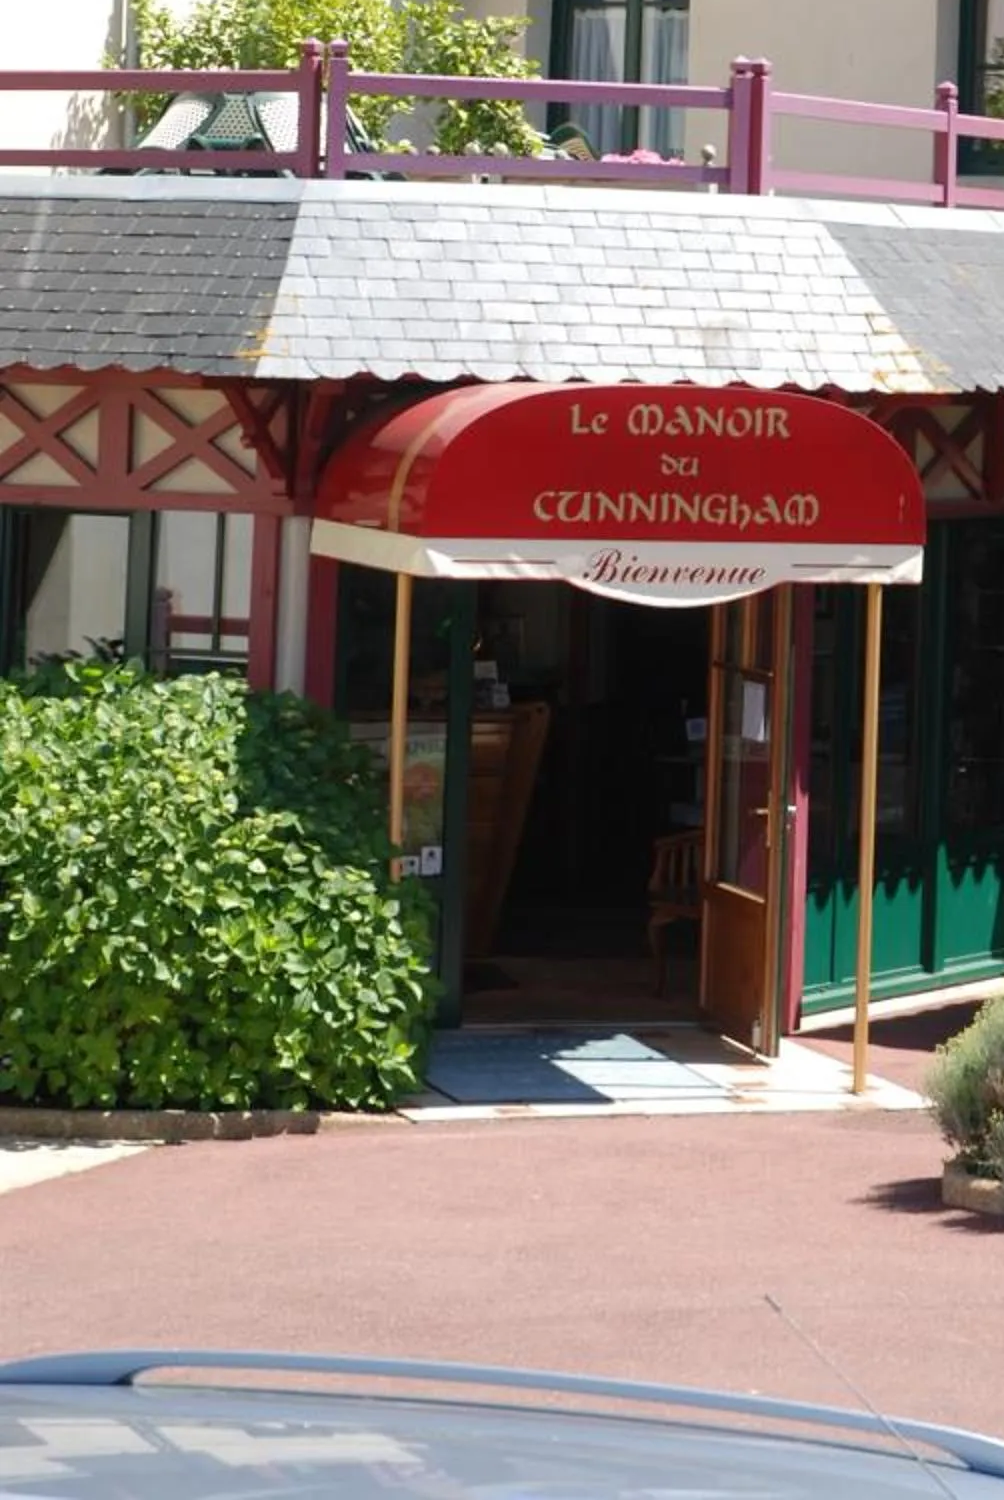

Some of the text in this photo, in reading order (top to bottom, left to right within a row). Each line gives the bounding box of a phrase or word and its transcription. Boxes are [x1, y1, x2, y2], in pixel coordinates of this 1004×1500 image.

[571, 404, 790, 438] Le MANOIR
[584, 549, 766, 585] Bienvenue
